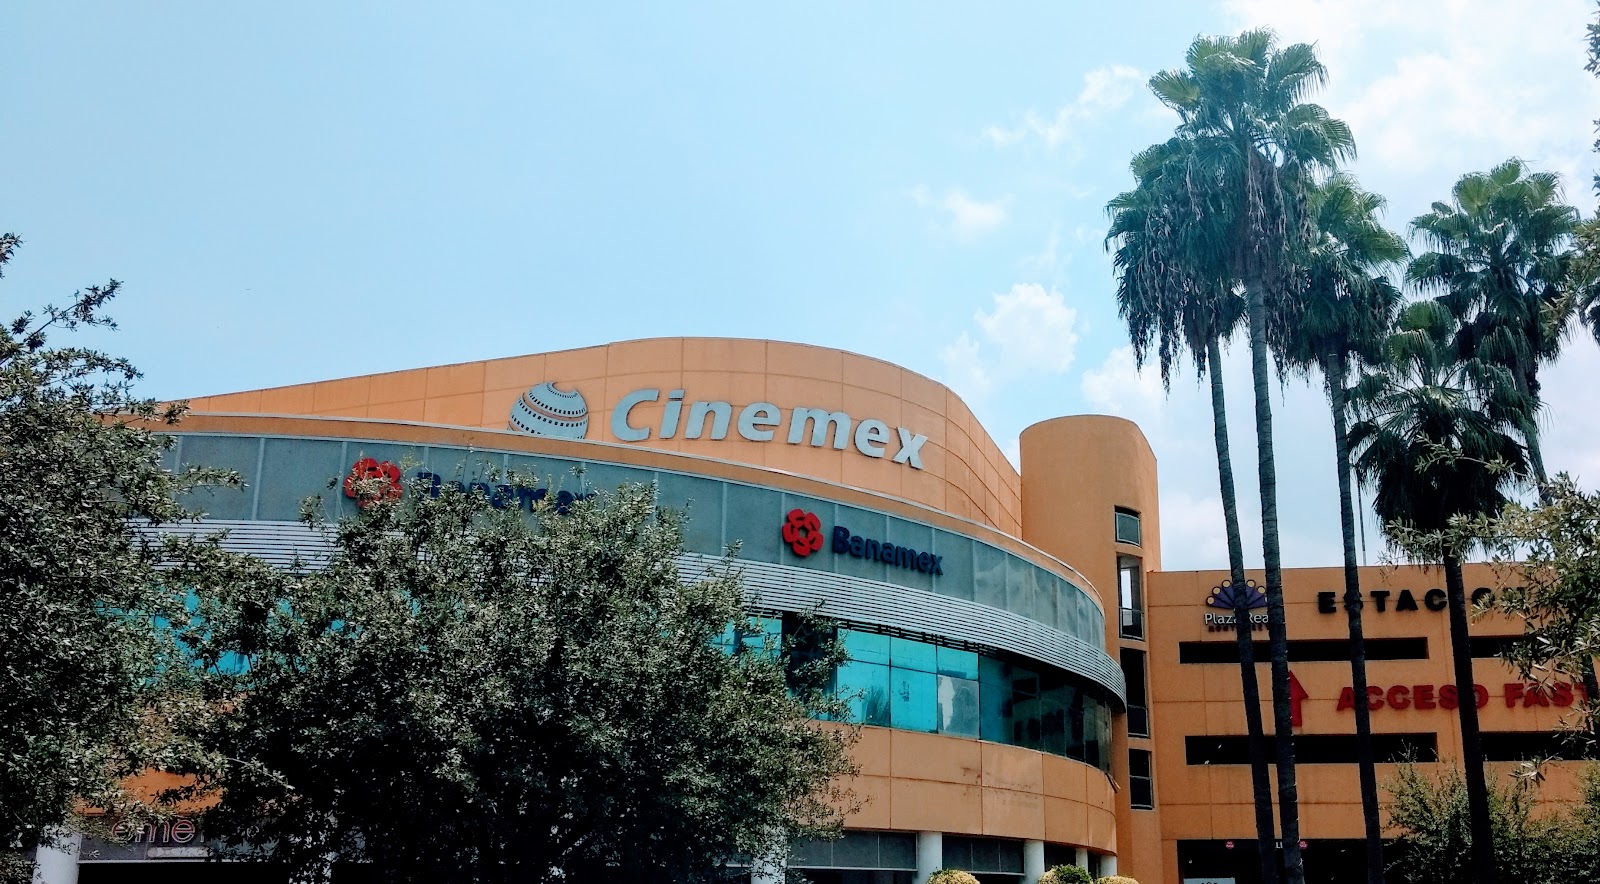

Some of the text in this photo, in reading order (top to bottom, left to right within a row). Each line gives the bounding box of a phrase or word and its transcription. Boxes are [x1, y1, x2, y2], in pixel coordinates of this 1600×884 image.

[610, 388, 928, 470] Cinemex
[416, 472, 598, 515] Bname
[832, 525, 944, 576] Banamex
